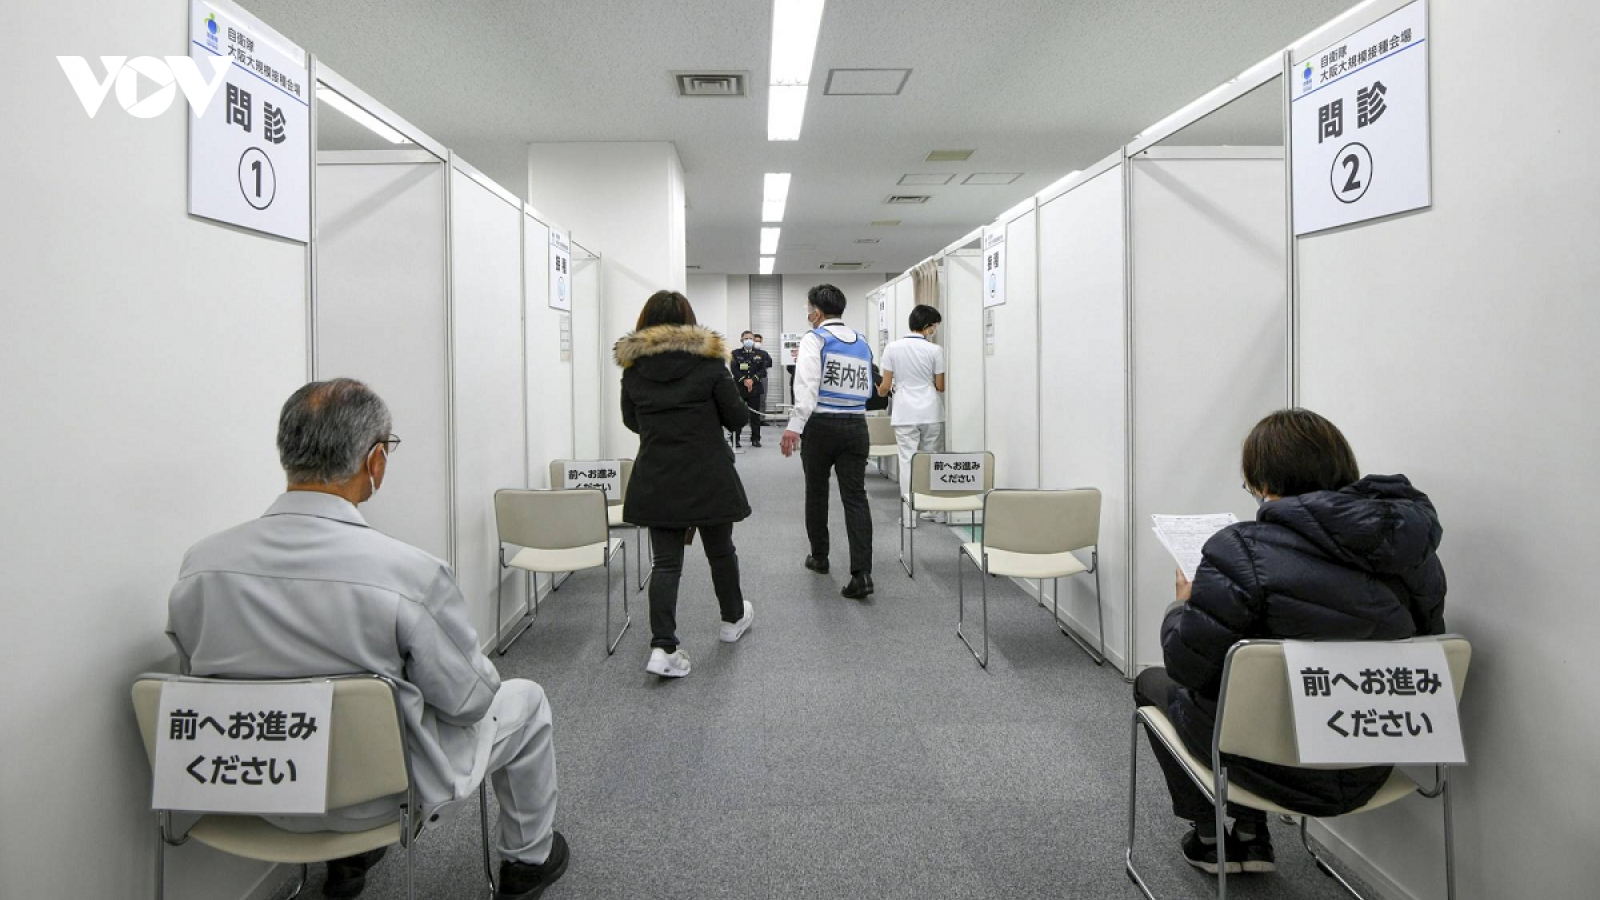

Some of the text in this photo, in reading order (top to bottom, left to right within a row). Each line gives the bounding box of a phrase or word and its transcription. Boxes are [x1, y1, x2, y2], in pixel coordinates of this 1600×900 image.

[227, 27, 254, 52] 自衛隊
[1319, 28, 1412, 83] 大阪大規模接種会場
[1320, 45, 1348, 69] 自衛隊
[823, 359, 869, 391] 案内係
[568, 469, 617, 480] 前へお進み
[934, 461, 981, 471] 前へお進み
[939, 474, 976, 483] ください
[1300, 667, 1442, 697] 前へお進み
[169, 709, 318, 742] 前へお進み
[1327, 709, 1433, 738] ください
[186, 755, 297, 785] ください
